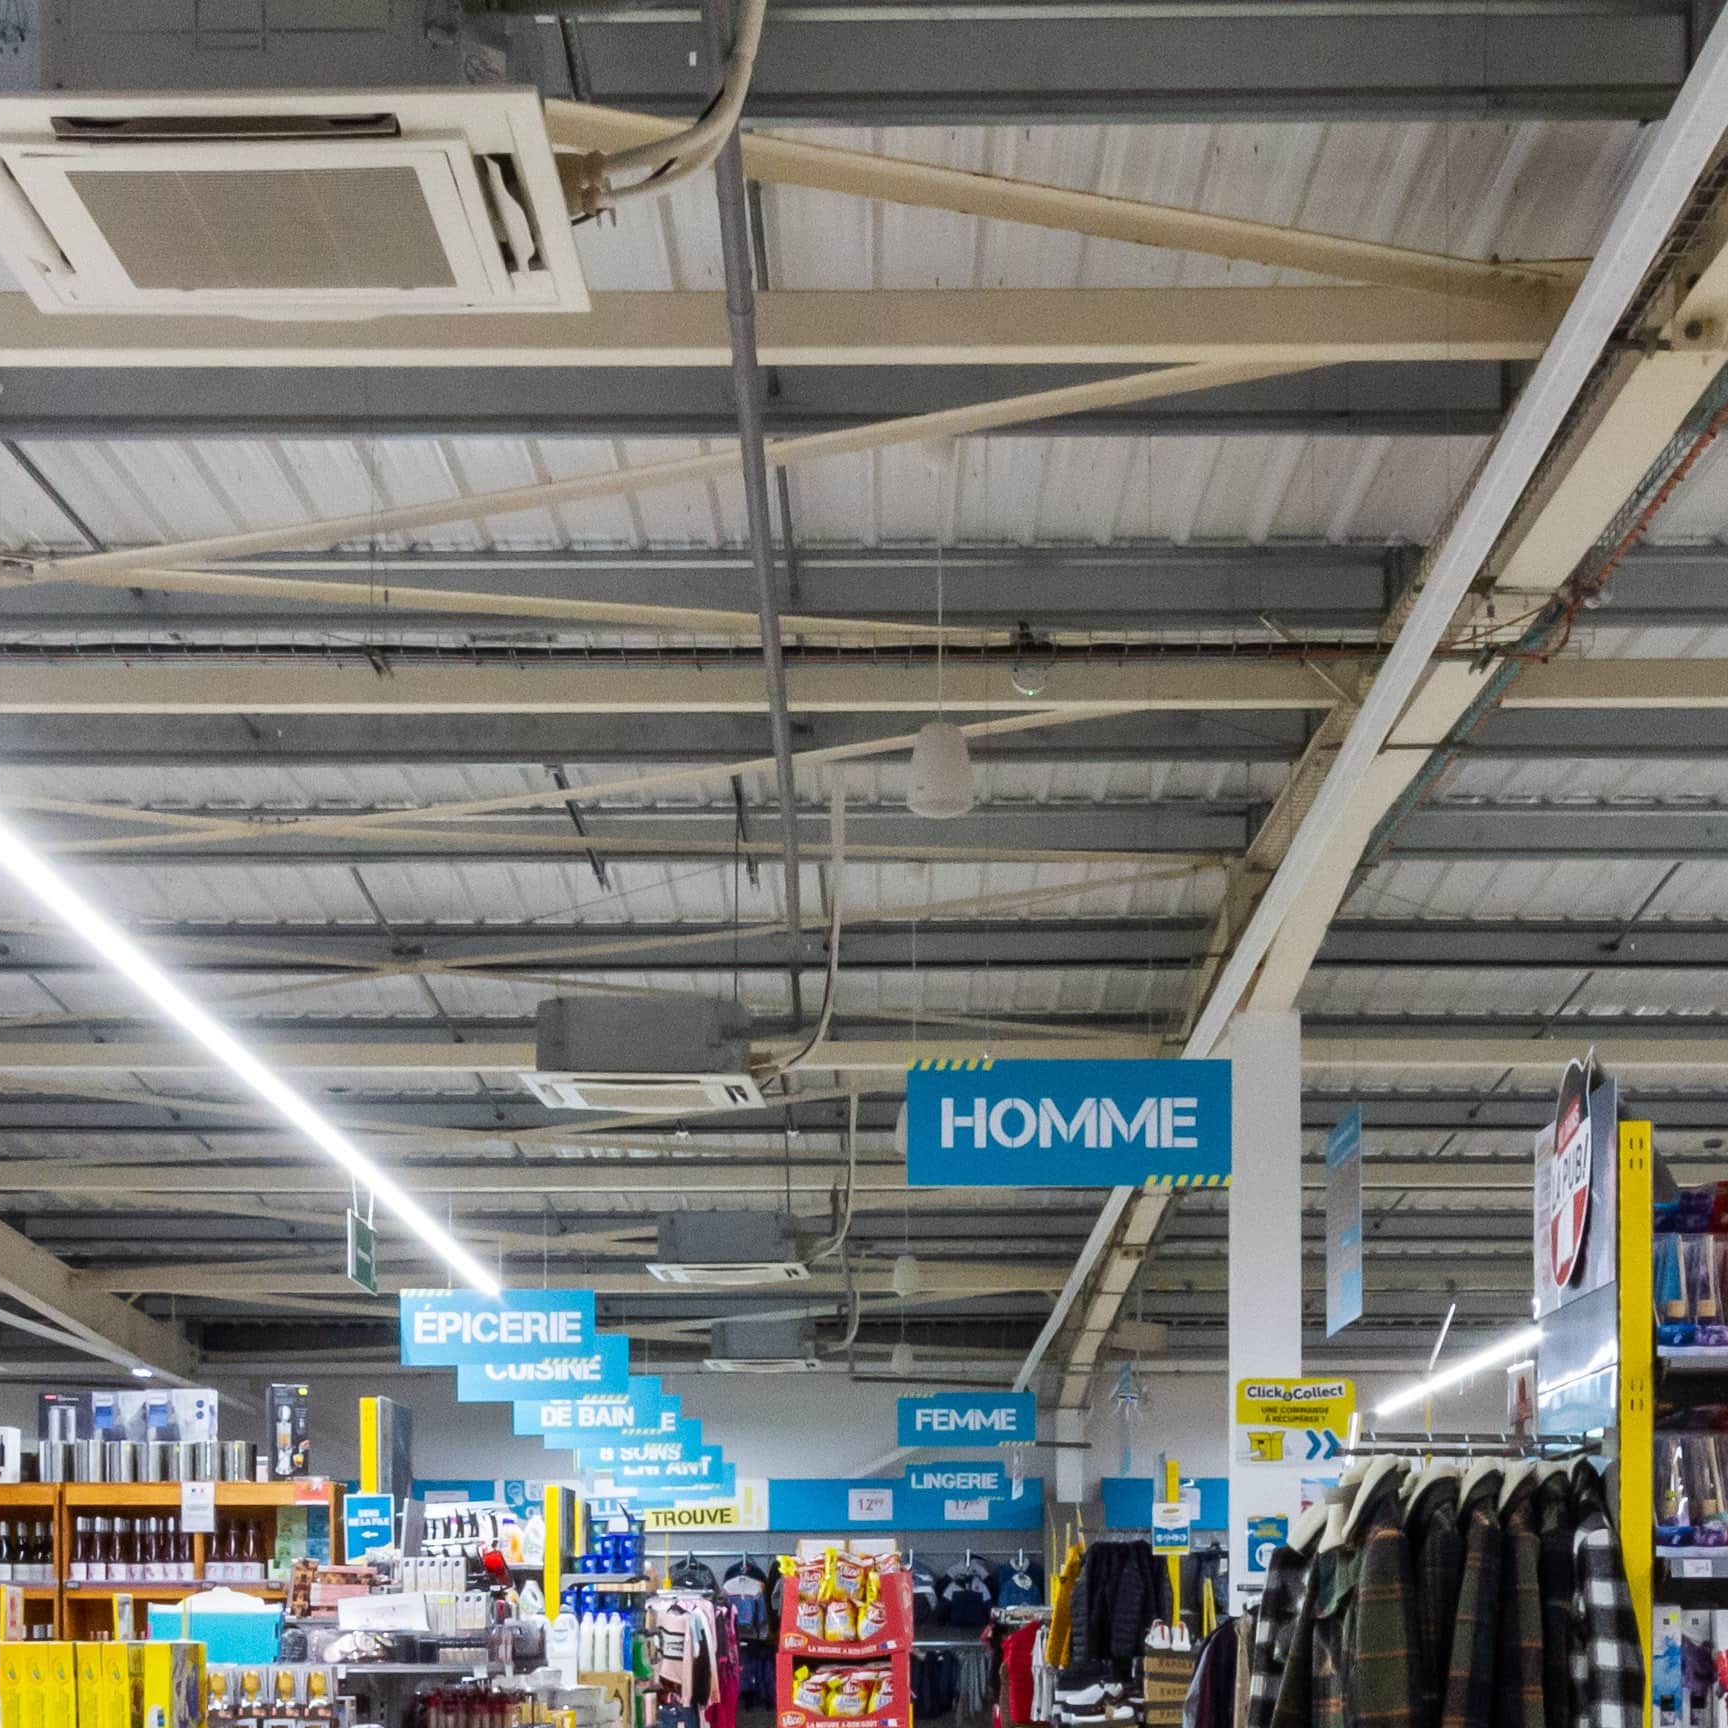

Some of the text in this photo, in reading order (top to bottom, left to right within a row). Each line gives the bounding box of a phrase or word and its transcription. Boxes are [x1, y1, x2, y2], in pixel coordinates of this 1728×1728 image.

[941, 1097, 1198, 1148] HOMME
[413, 1303, 582, 1344] ÉPICERIE
[540, 1406, 635, 1427] DE BAIN
[915, 1408, 1017, 1431] FEMME
[911, 1473, 998, 1490] LINGERIE
[652, 1507, 732, 1526] TROUVE
